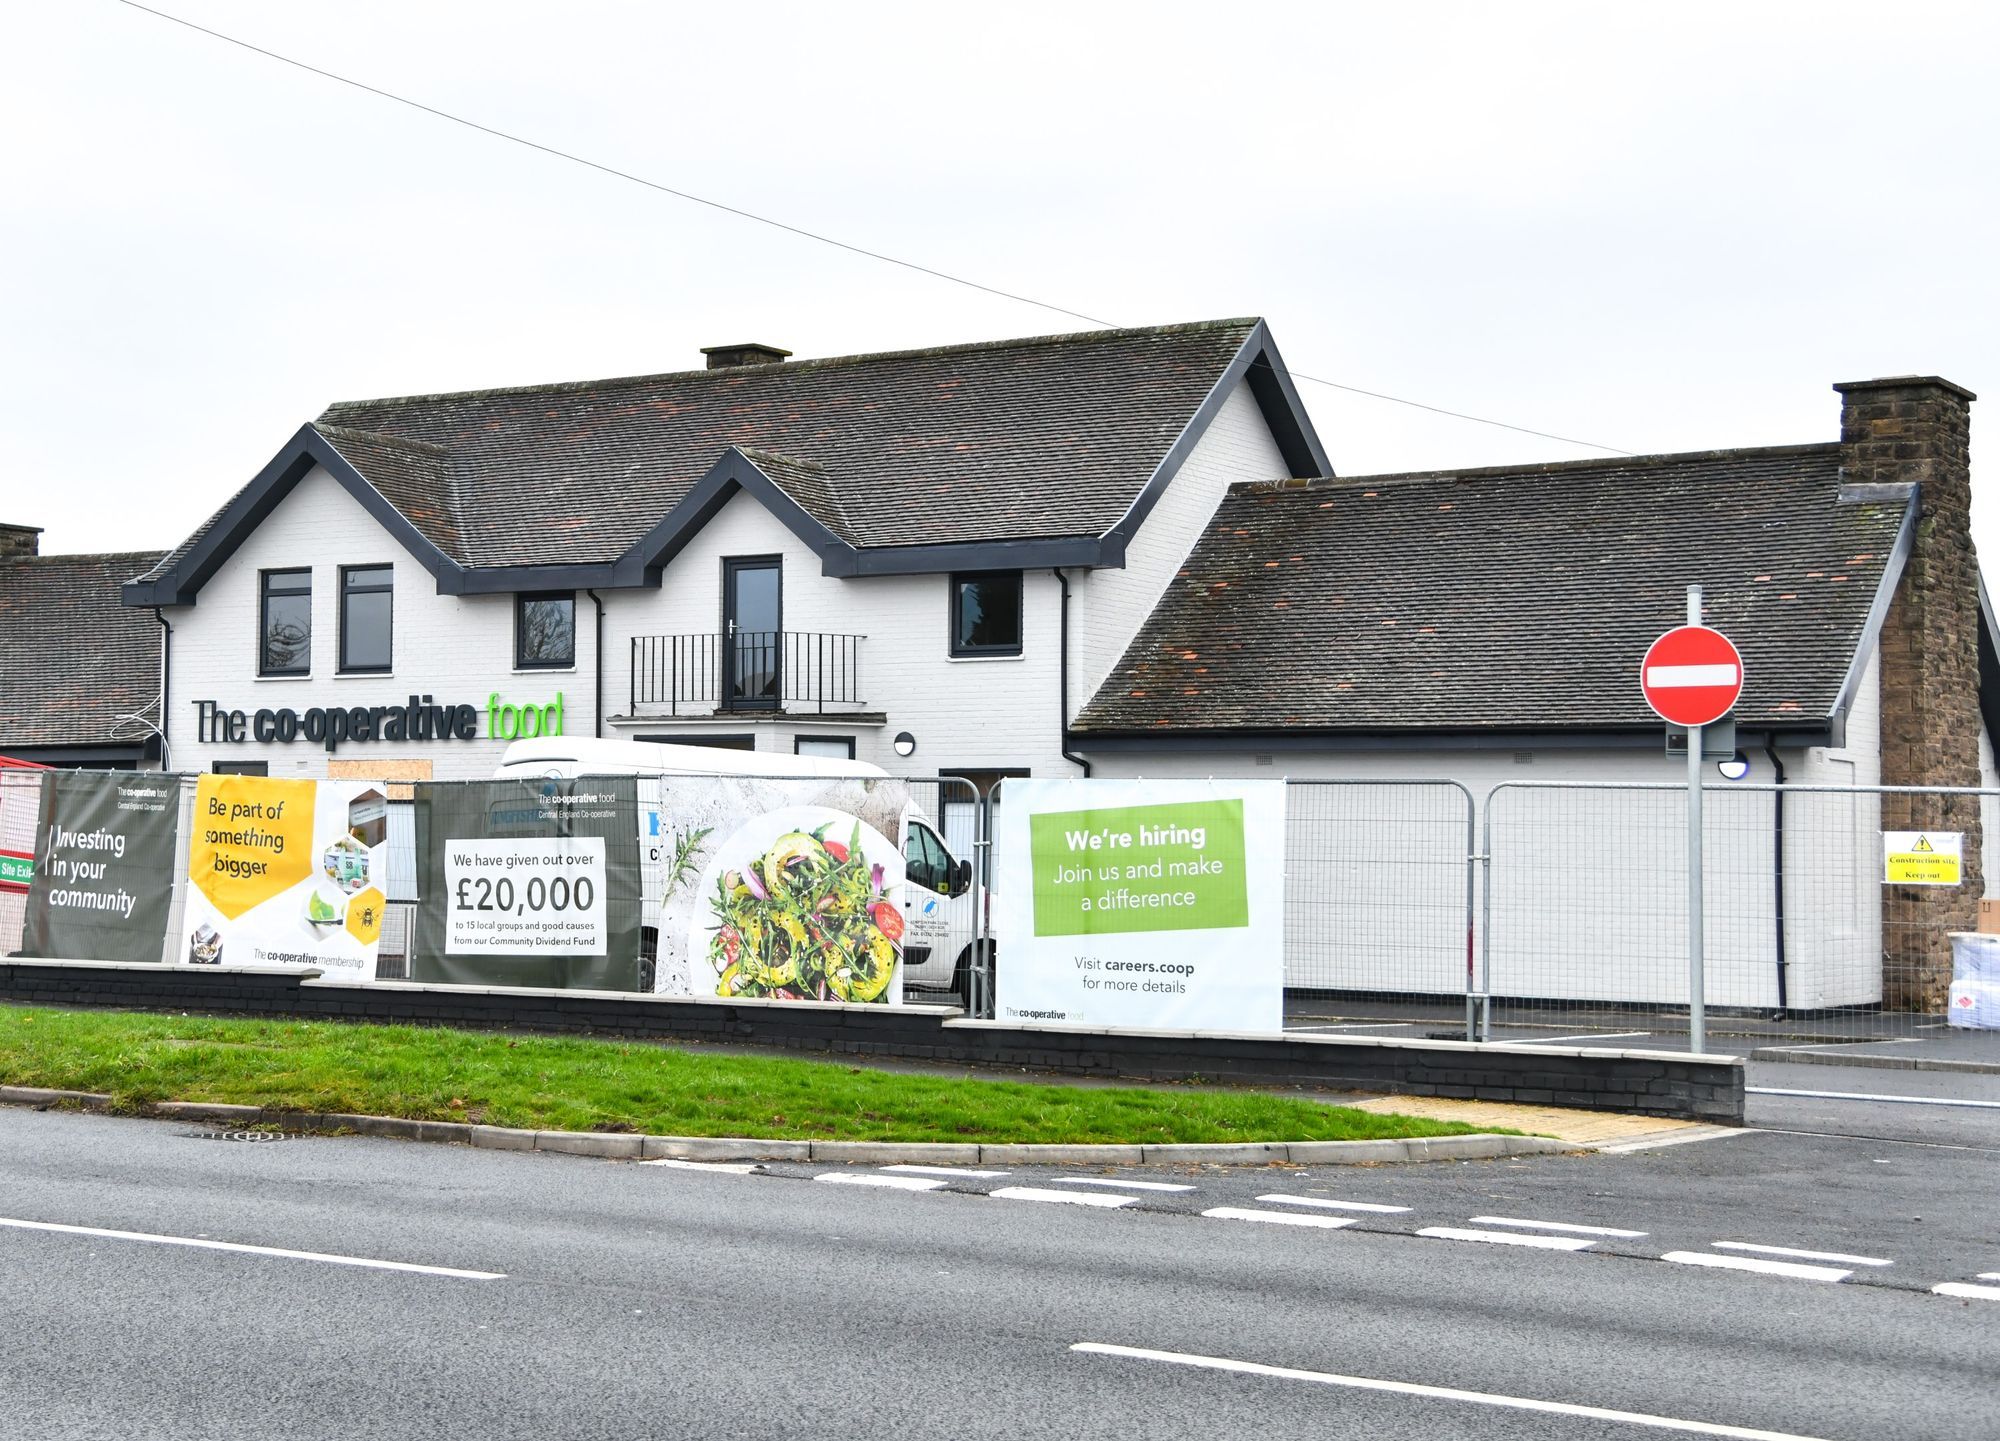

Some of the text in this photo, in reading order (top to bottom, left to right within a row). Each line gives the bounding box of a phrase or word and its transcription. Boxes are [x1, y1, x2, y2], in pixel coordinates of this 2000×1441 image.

[192, 692, 564, 752] The co-operative food
[117, 787, 127, 796] The
[538, 792, 616, 806] The co-operative food
[209, 797, 285, 822] Be part of
[538, 810, 616, 820] Central England Co-operative
[56, 825, 126, 858] Investing
[205, 827, 284, 854] something
[1065, 823, 1206, 851] We're hiring
[1, 862, 16, 877] Site
[53, 853, 107, 884] in your
[214, 852, 267, 878] bigger
[453, 853, 594, 870] We have given out over
[1053, 855, 1223, 884] Join us and make
[1889, 856, 1940, 864] Construction
[1905, 872, 1925, 880] Keep
[49, 888, 137, 919] community
[456, 876, 594, 916] £20,000
[1081, 888, 1195, 911] a difference
[455, 922, 464, 930] to
[466, 921, 475, 930] 15
[476, 921, 496, 930] local
[497, 922, 524, 932] groups
[525, 921, 540, 930] and
[541, 921, 564, 932] good
[454, 936, 472, 945] from
[489, 936, 534, 948] Community
[535, 937, 571, 946] Dividend
[573, 937, 596, 946] Fund
[254, 948, 364, 970] The co-operative membership
[1074, 956, 1195, 977] Visit careers.coop
[1082, 975, 1186, 994] for more details
[1006, 1006, 1085, 1021] The co-operative food
